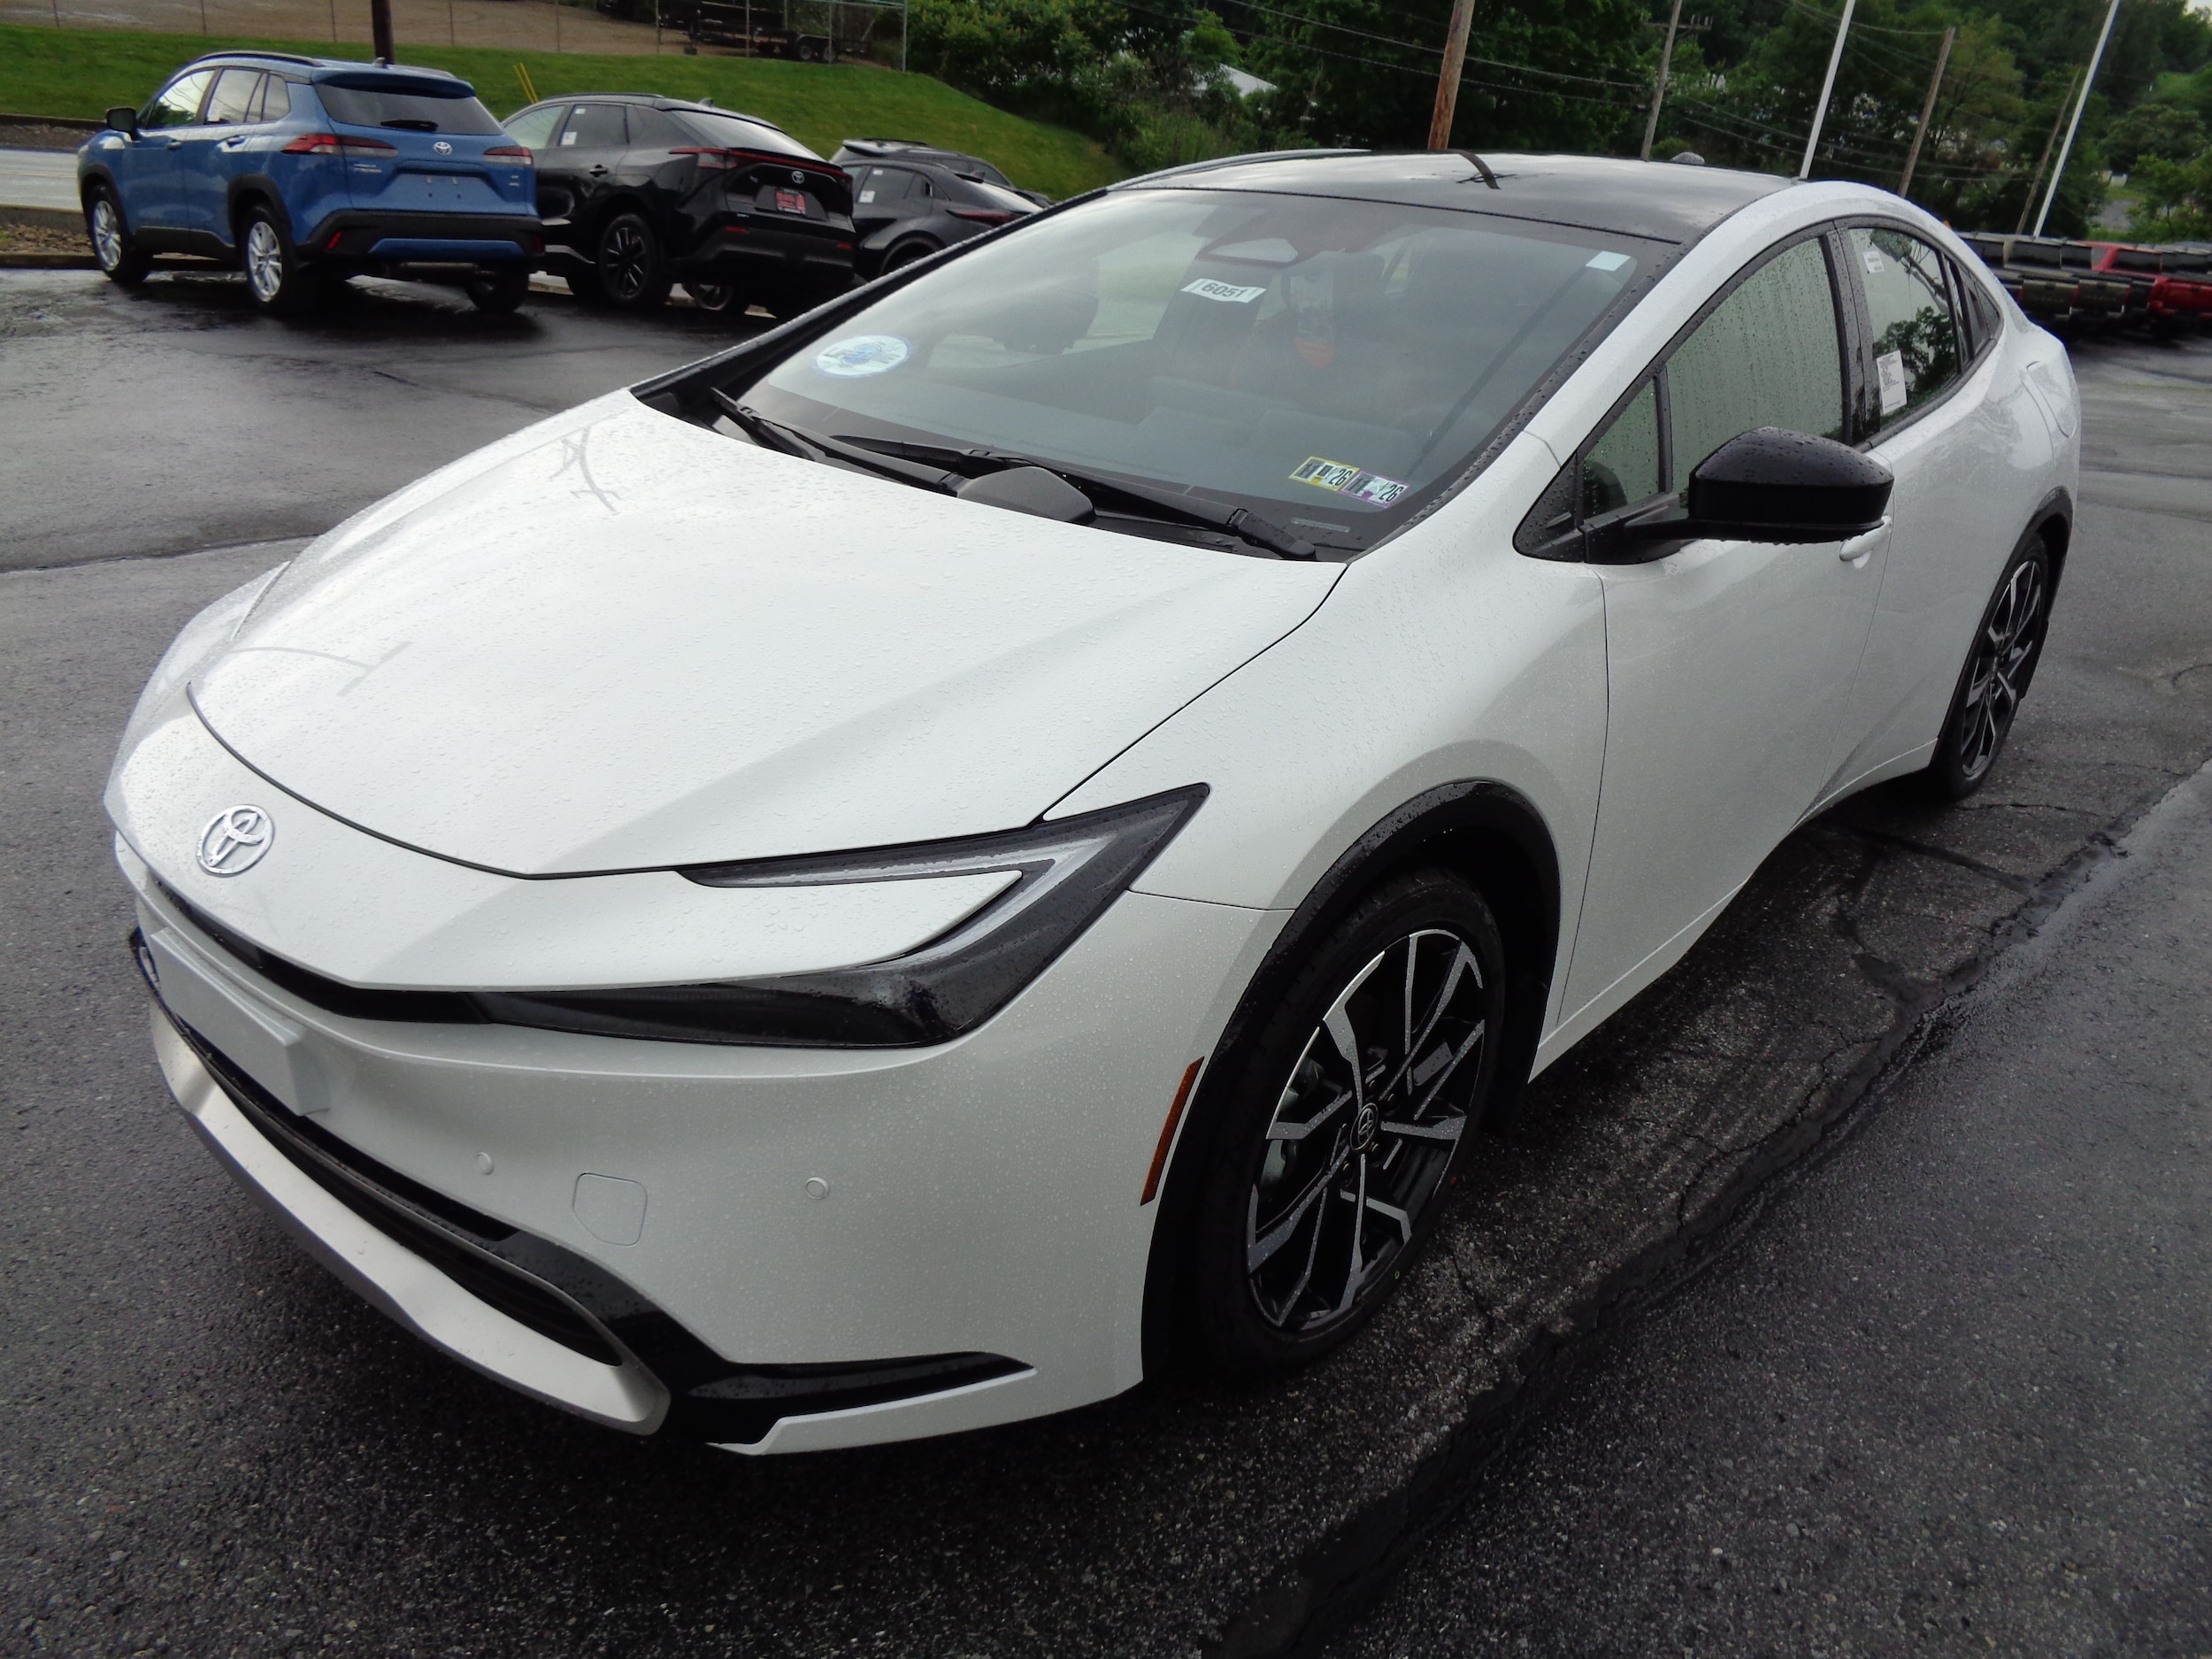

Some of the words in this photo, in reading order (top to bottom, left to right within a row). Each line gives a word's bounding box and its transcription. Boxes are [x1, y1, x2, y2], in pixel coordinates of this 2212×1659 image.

[1202, 282, 1248, 298] 6051
[1327, 469, 1353, 487] 26
[1379, 484, 1404, 503] 26
